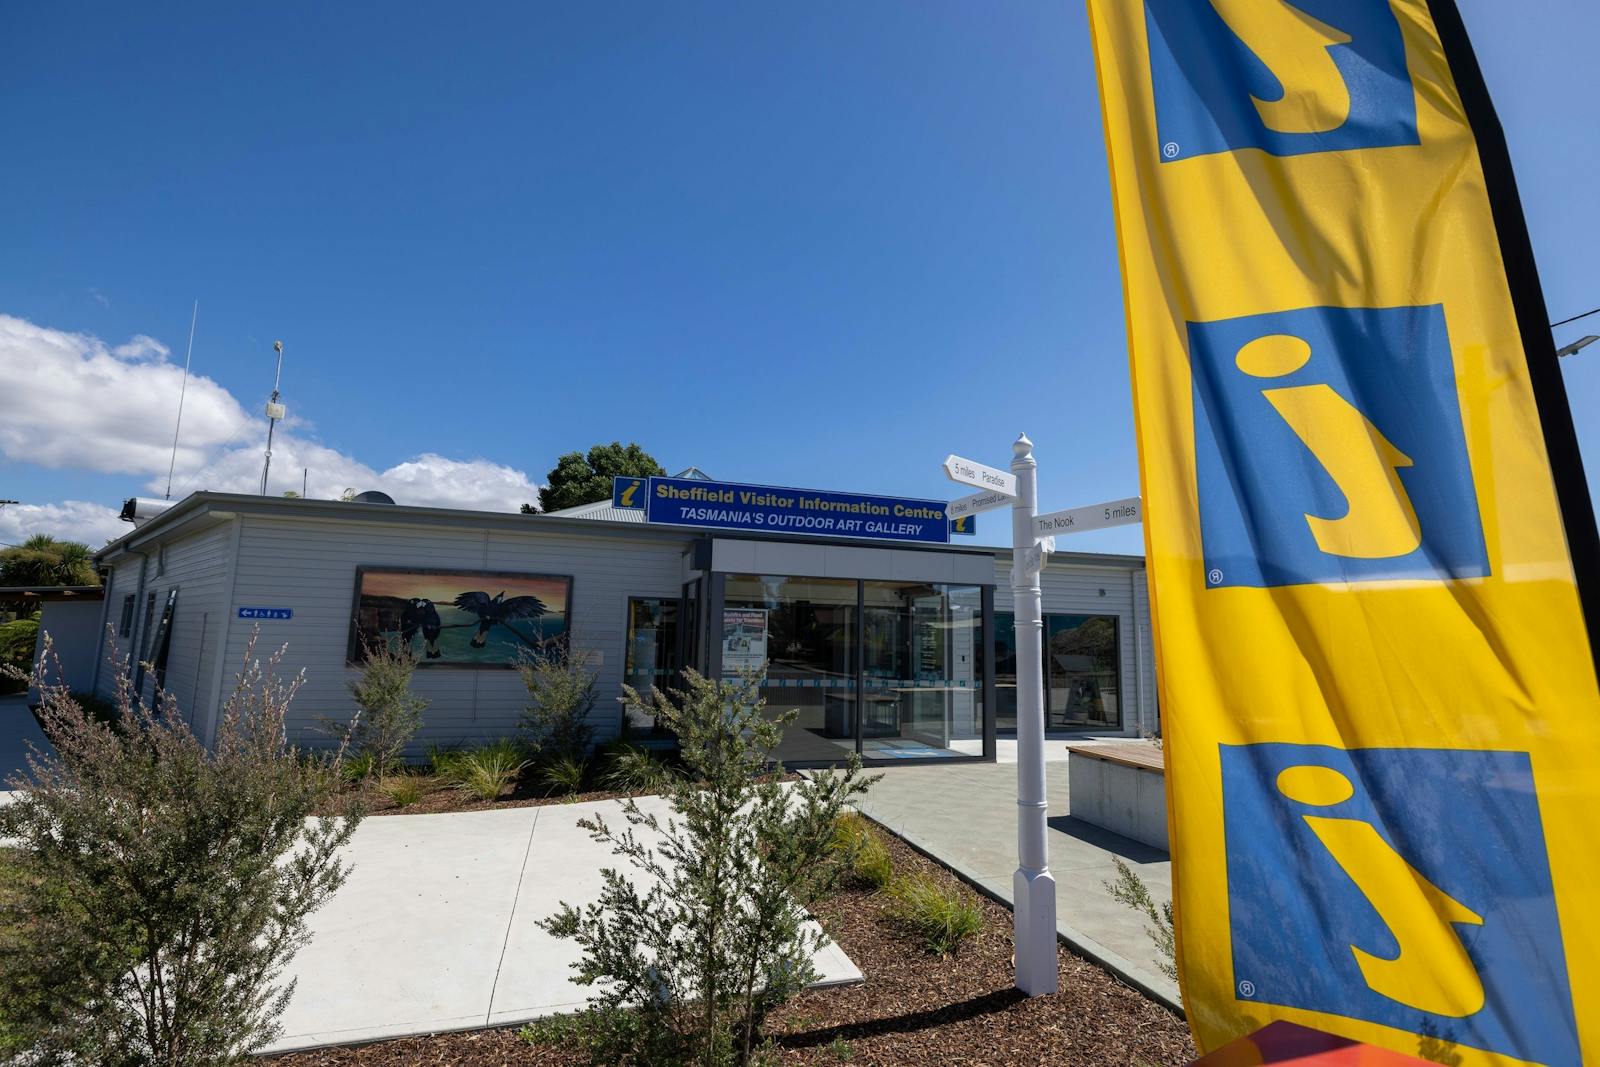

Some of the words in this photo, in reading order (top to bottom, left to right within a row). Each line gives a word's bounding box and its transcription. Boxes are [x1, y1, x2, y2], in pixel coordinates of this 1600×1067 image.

[954, 463, 960, 474] 5
[960, 465, 976, 480] miles
[982, 471, 1005, 488] Paradise
[656, 484, 734, 504] Sheffield
[740, 491, 795, 508] Visitor
[799, 496, 890, 516] Information
[894, 504, 944, 520] Centre
[972, 494, 997, 508] Promised
[680, 507, 765, 525] TASMANIA'S
[767, 514, 835, 530] OUTDOOR
[836, 518, 864, 532] ART
[866, 521, 924, 536] GALLERY
[1039, 519, 1053, 531] The
[1054, 515, 1074, 528] Nook
[1104, 508, 1111, 520] 5
[1112, 505, 1136, 519] miles
